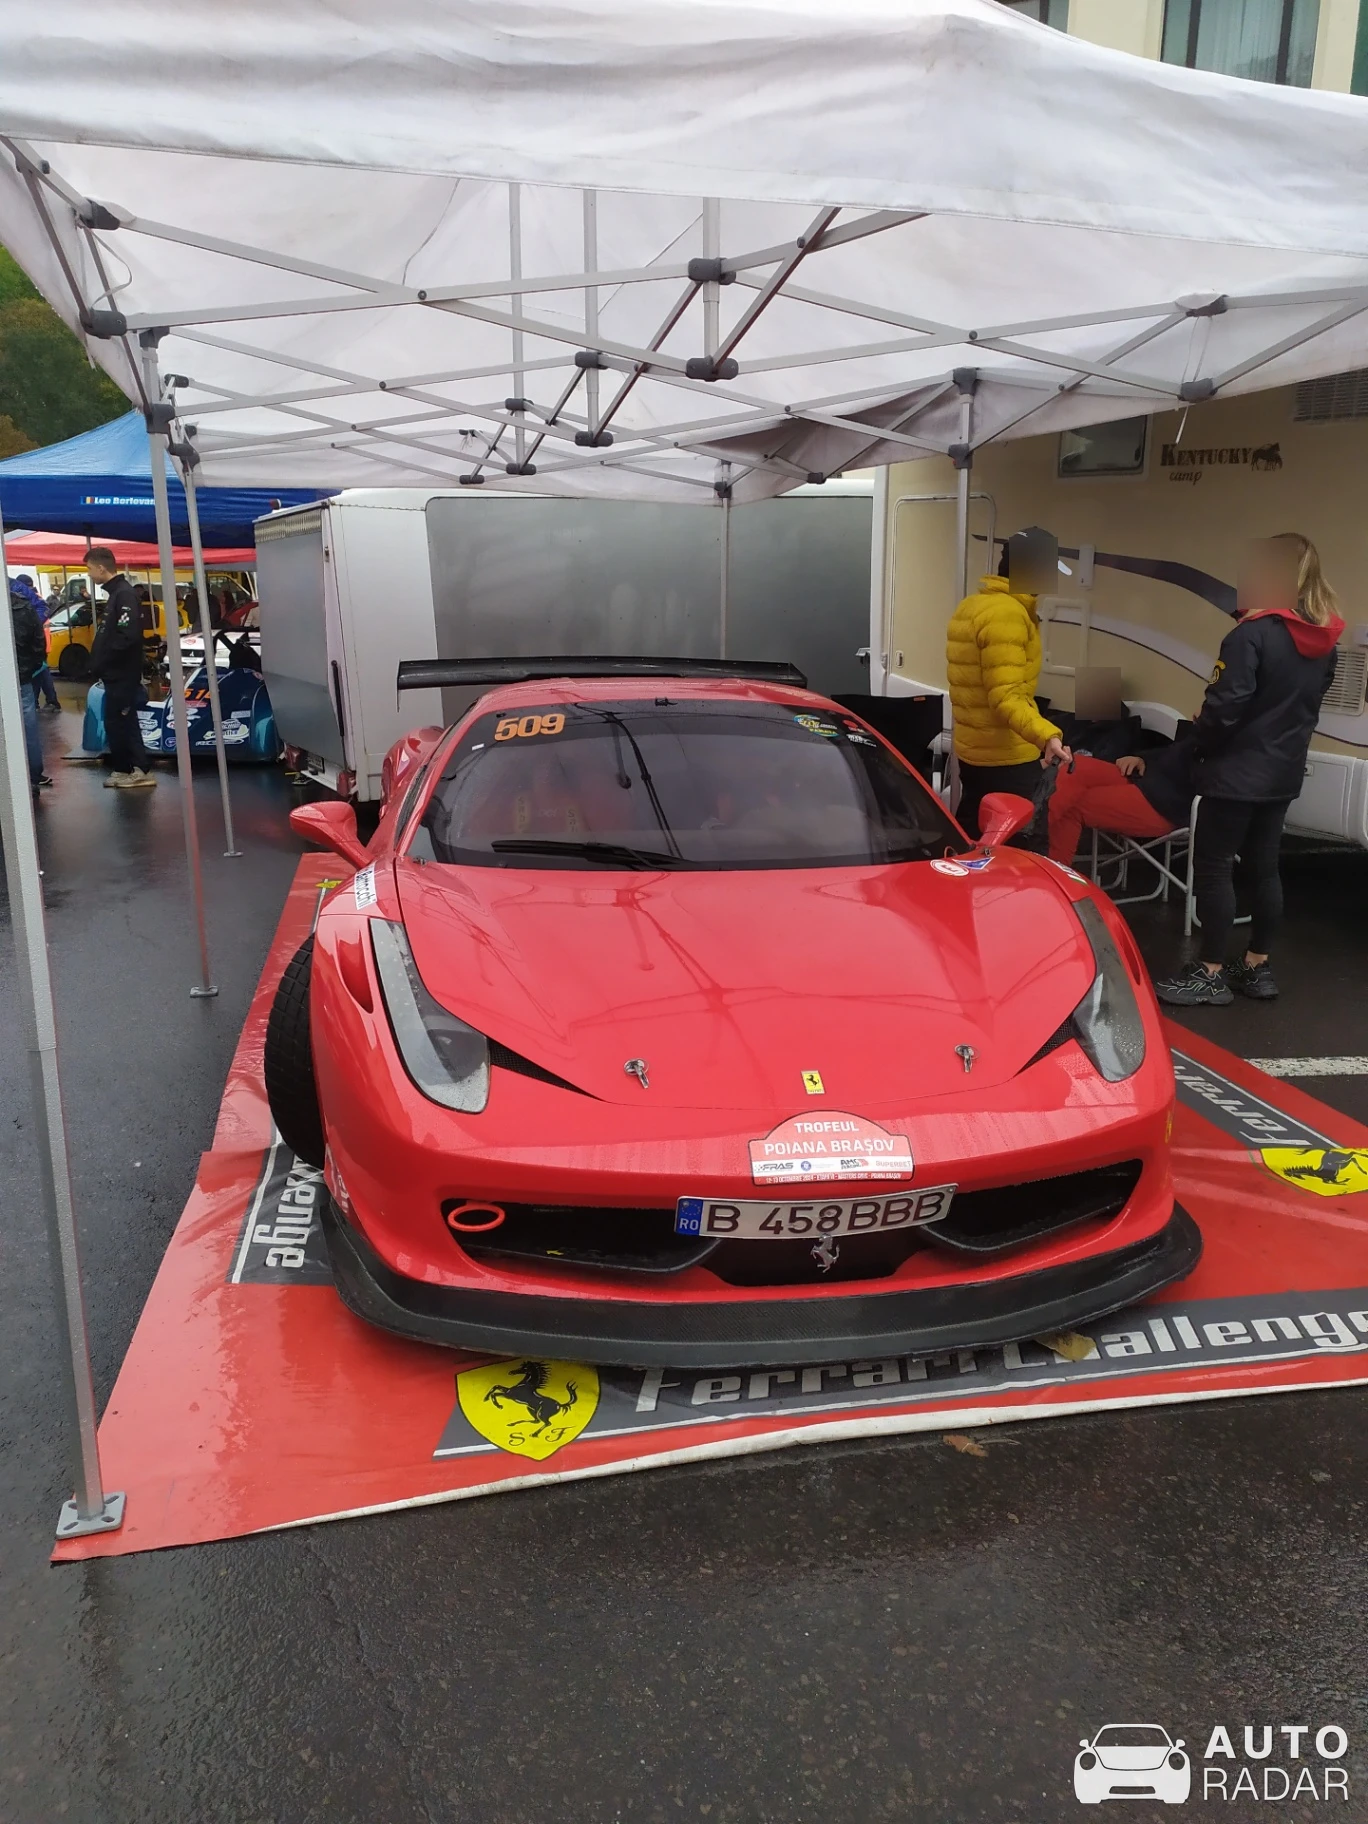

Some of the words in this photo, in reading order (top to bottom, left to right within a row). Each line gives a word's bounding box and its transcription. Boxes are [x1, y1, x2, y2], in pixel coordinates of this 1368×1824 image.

[1160, 444, 1252, 466] KENTUCKY
[1169, 471, 1202, 486] camp
[494, 713, 566, 741] 509
[1174, 1065, 1312, 1146] Ferrar
[794, 1121, 860, 1133] TROFEUL
[764, 1141, 827, 1156] POIANA
[679, 1218, 699, 1231] RO
[706, 1204, 741, 1233] B
[508, 1432, 525, 1447] S
[545, 1426, 575, 1443] F
